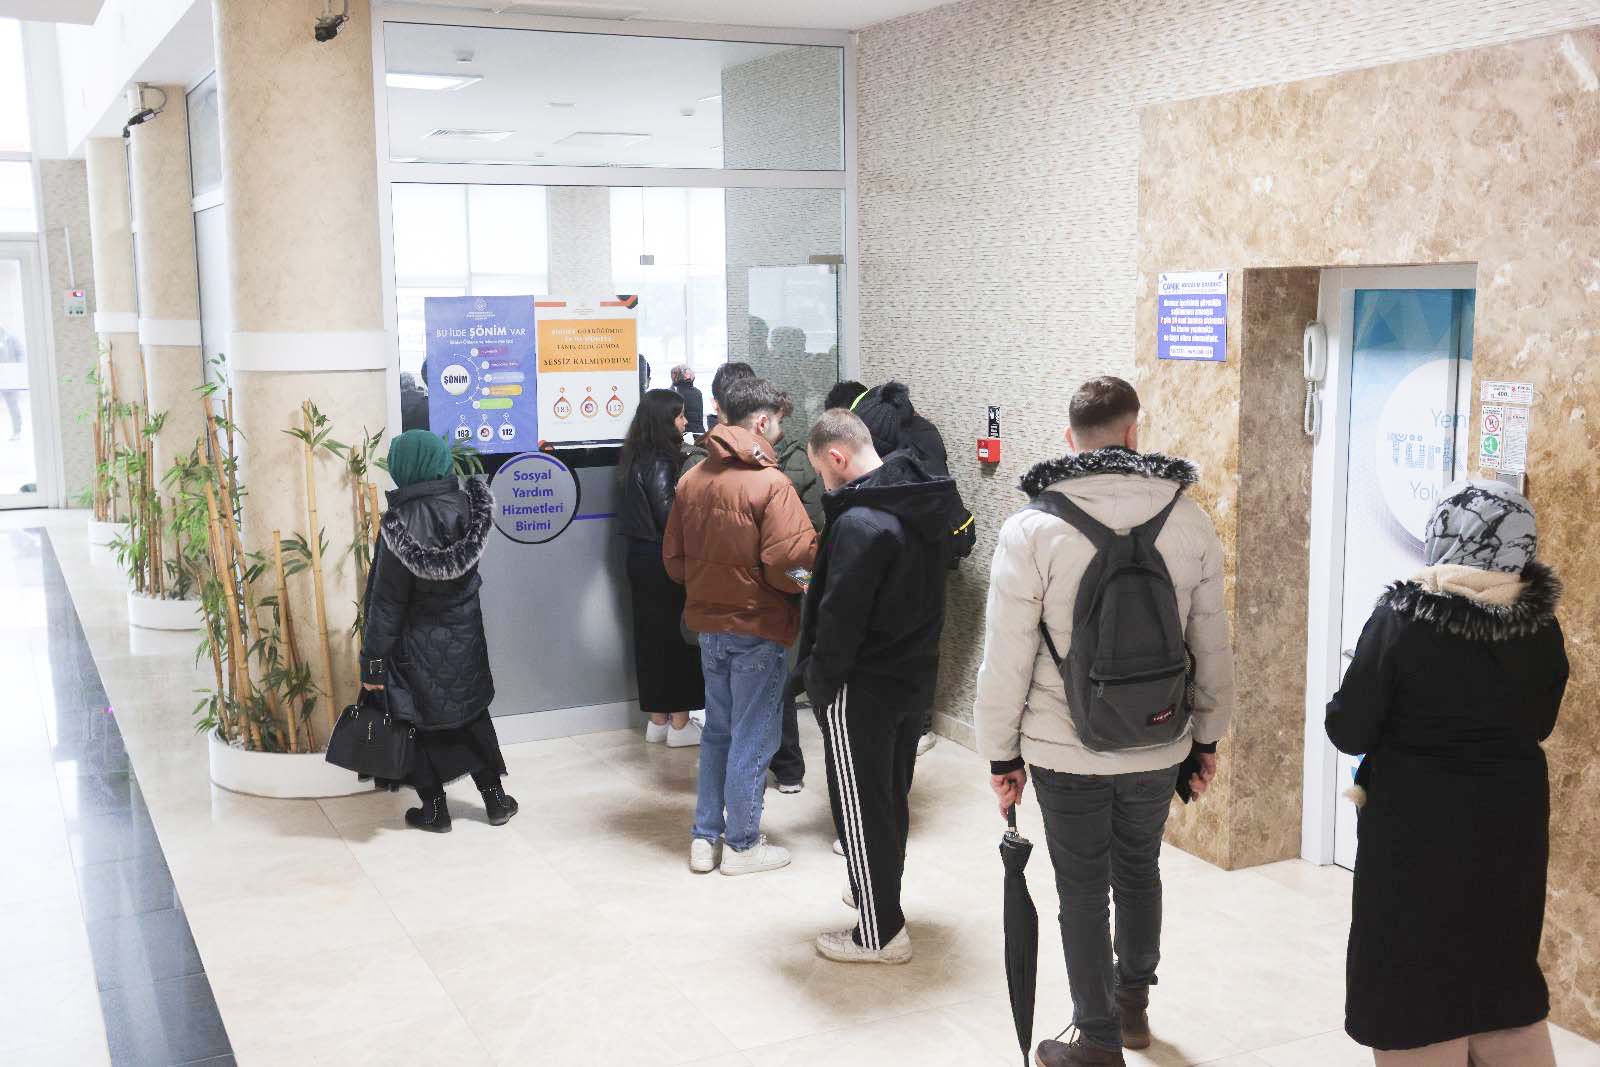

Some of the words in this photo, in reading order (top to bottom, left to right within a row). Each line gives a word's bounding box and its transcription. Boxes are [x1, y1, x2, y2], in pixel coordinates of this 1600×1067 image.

[436, 327, 447, 337] BU
[449, 327, 467, 337] İLDE
[469, 325, 507, 339] ŞÖNİM
[510, 328, 526, 336] VAR
[544, 358, 571, 366] SESSİZ
[513, 469, 551, 483] Sosyal
[512, 487, 553, 498] Yardım
[502, 502, 564, 515] Hizmetleri
[515, 520, 551, 531] Birimi
